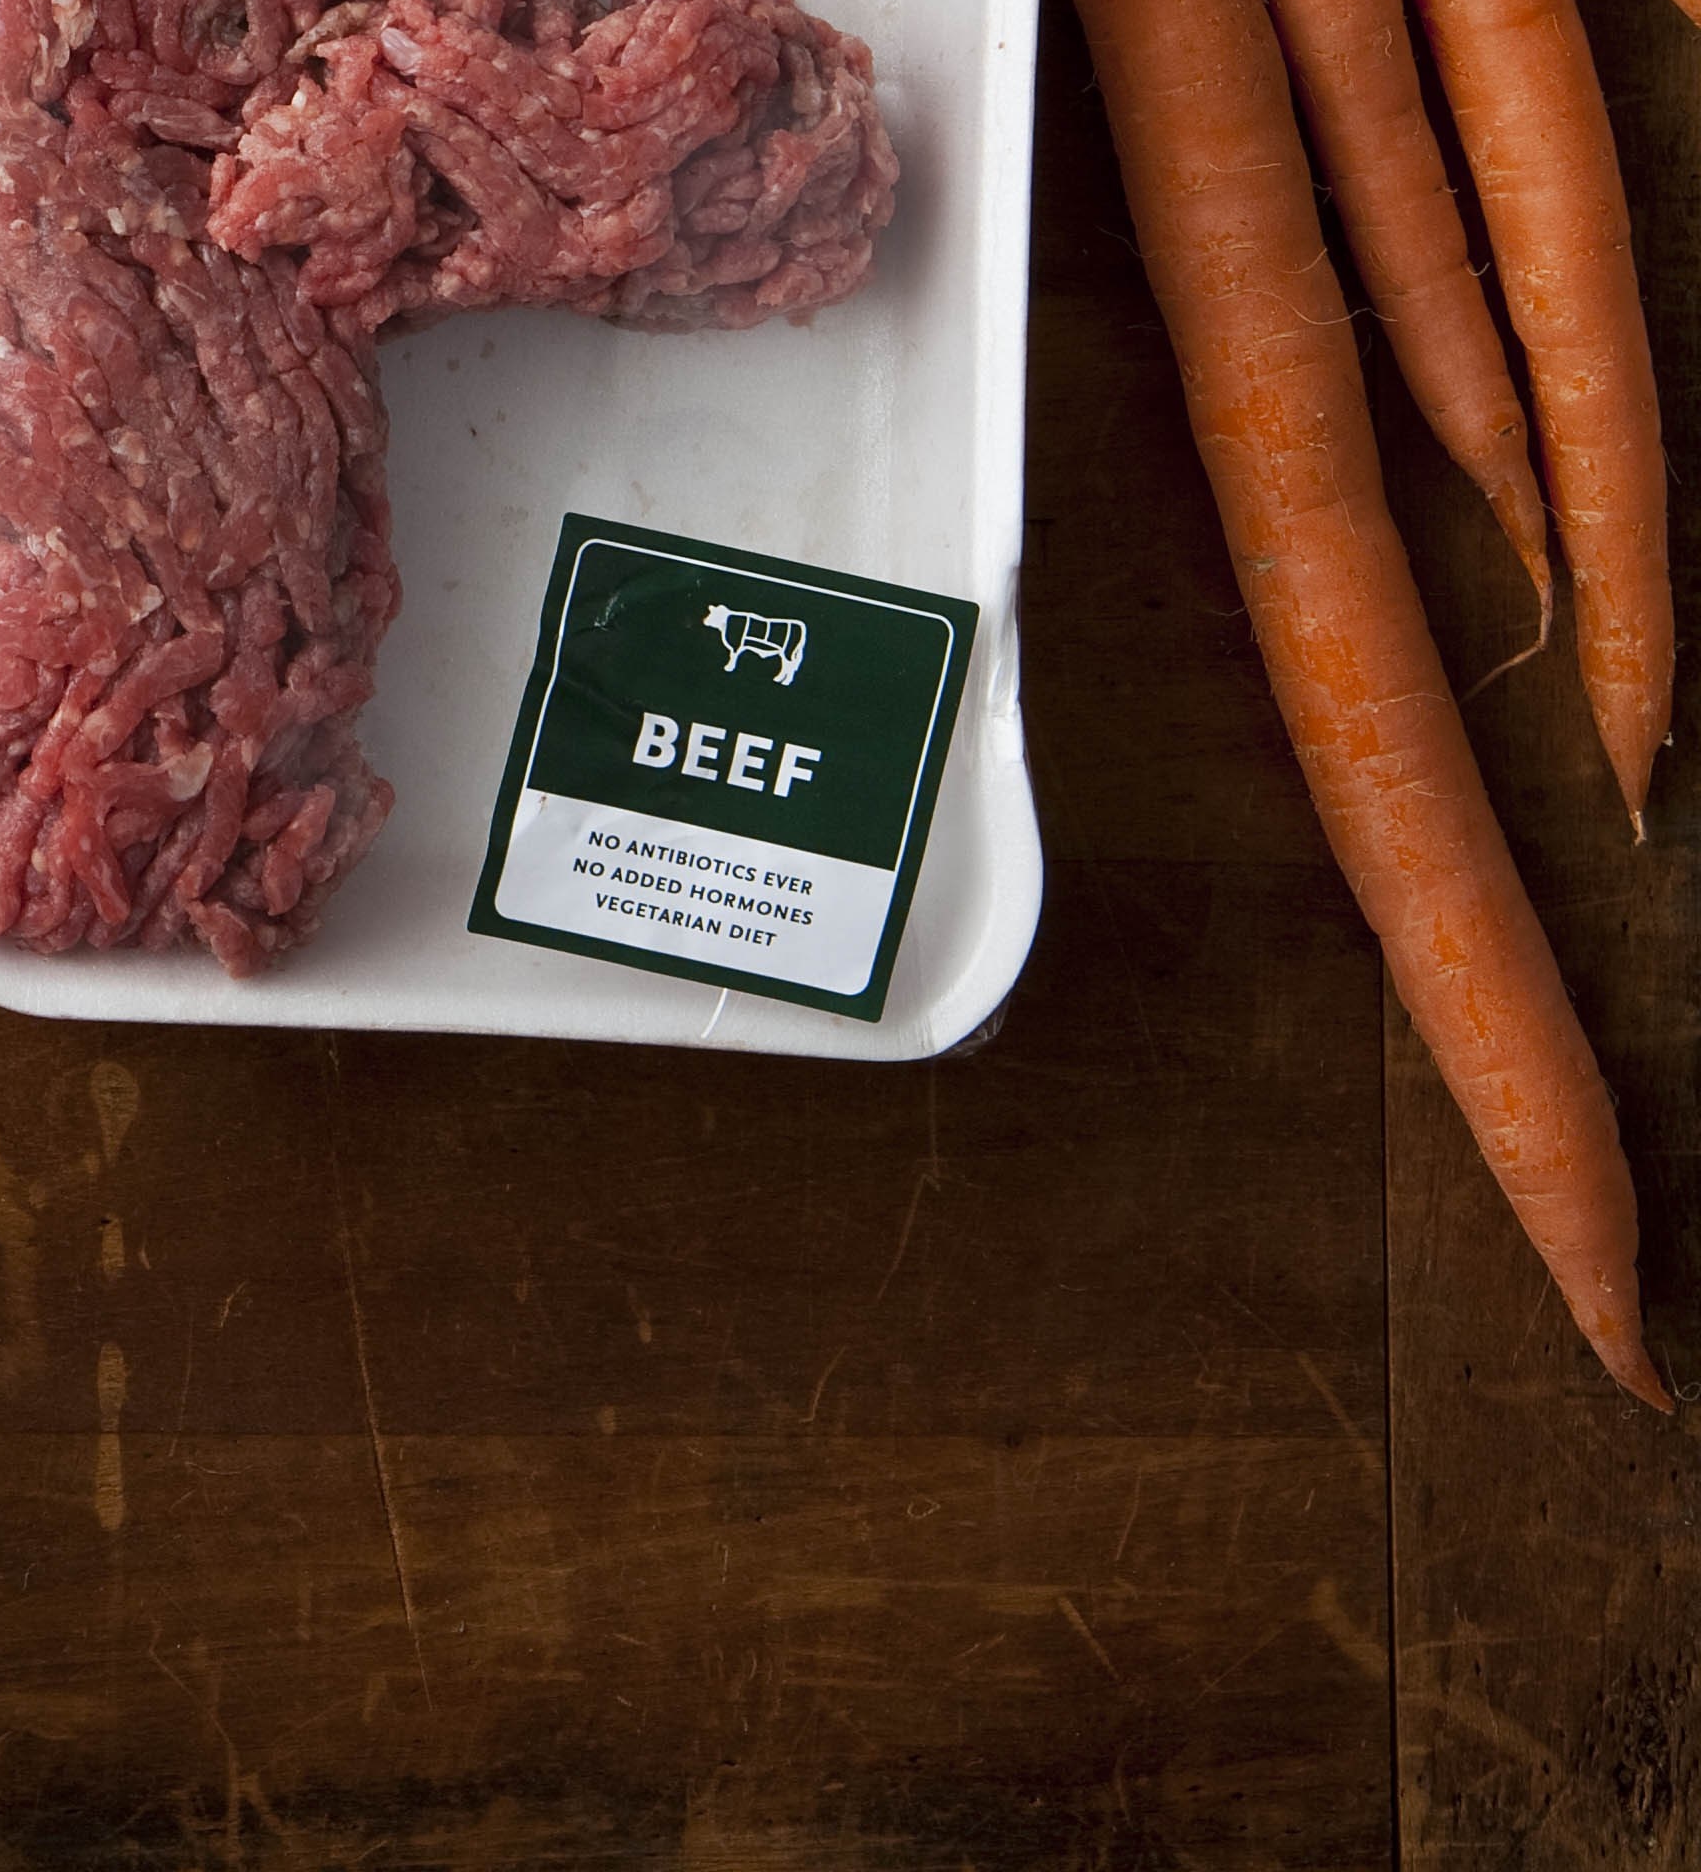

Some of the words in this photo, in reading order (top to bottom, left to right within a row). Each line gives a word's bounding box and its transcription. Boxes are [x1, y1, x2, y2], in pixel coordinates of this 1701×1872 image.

[632, 712, 821, 798] BEEF
[573, 858, 605, 877] NO
[611, 868, 682, 894] ADDED
[690, 885, 814, 925] HORMONES
[588, 831, 620, 850] NO
[626, 841, 756, 882] ANTIBIOTICS
[764, 872, 813, 895] EVER
[596, 894, 721, 935] VEGETARIAN
[729, 925, 777, 946] DIET
